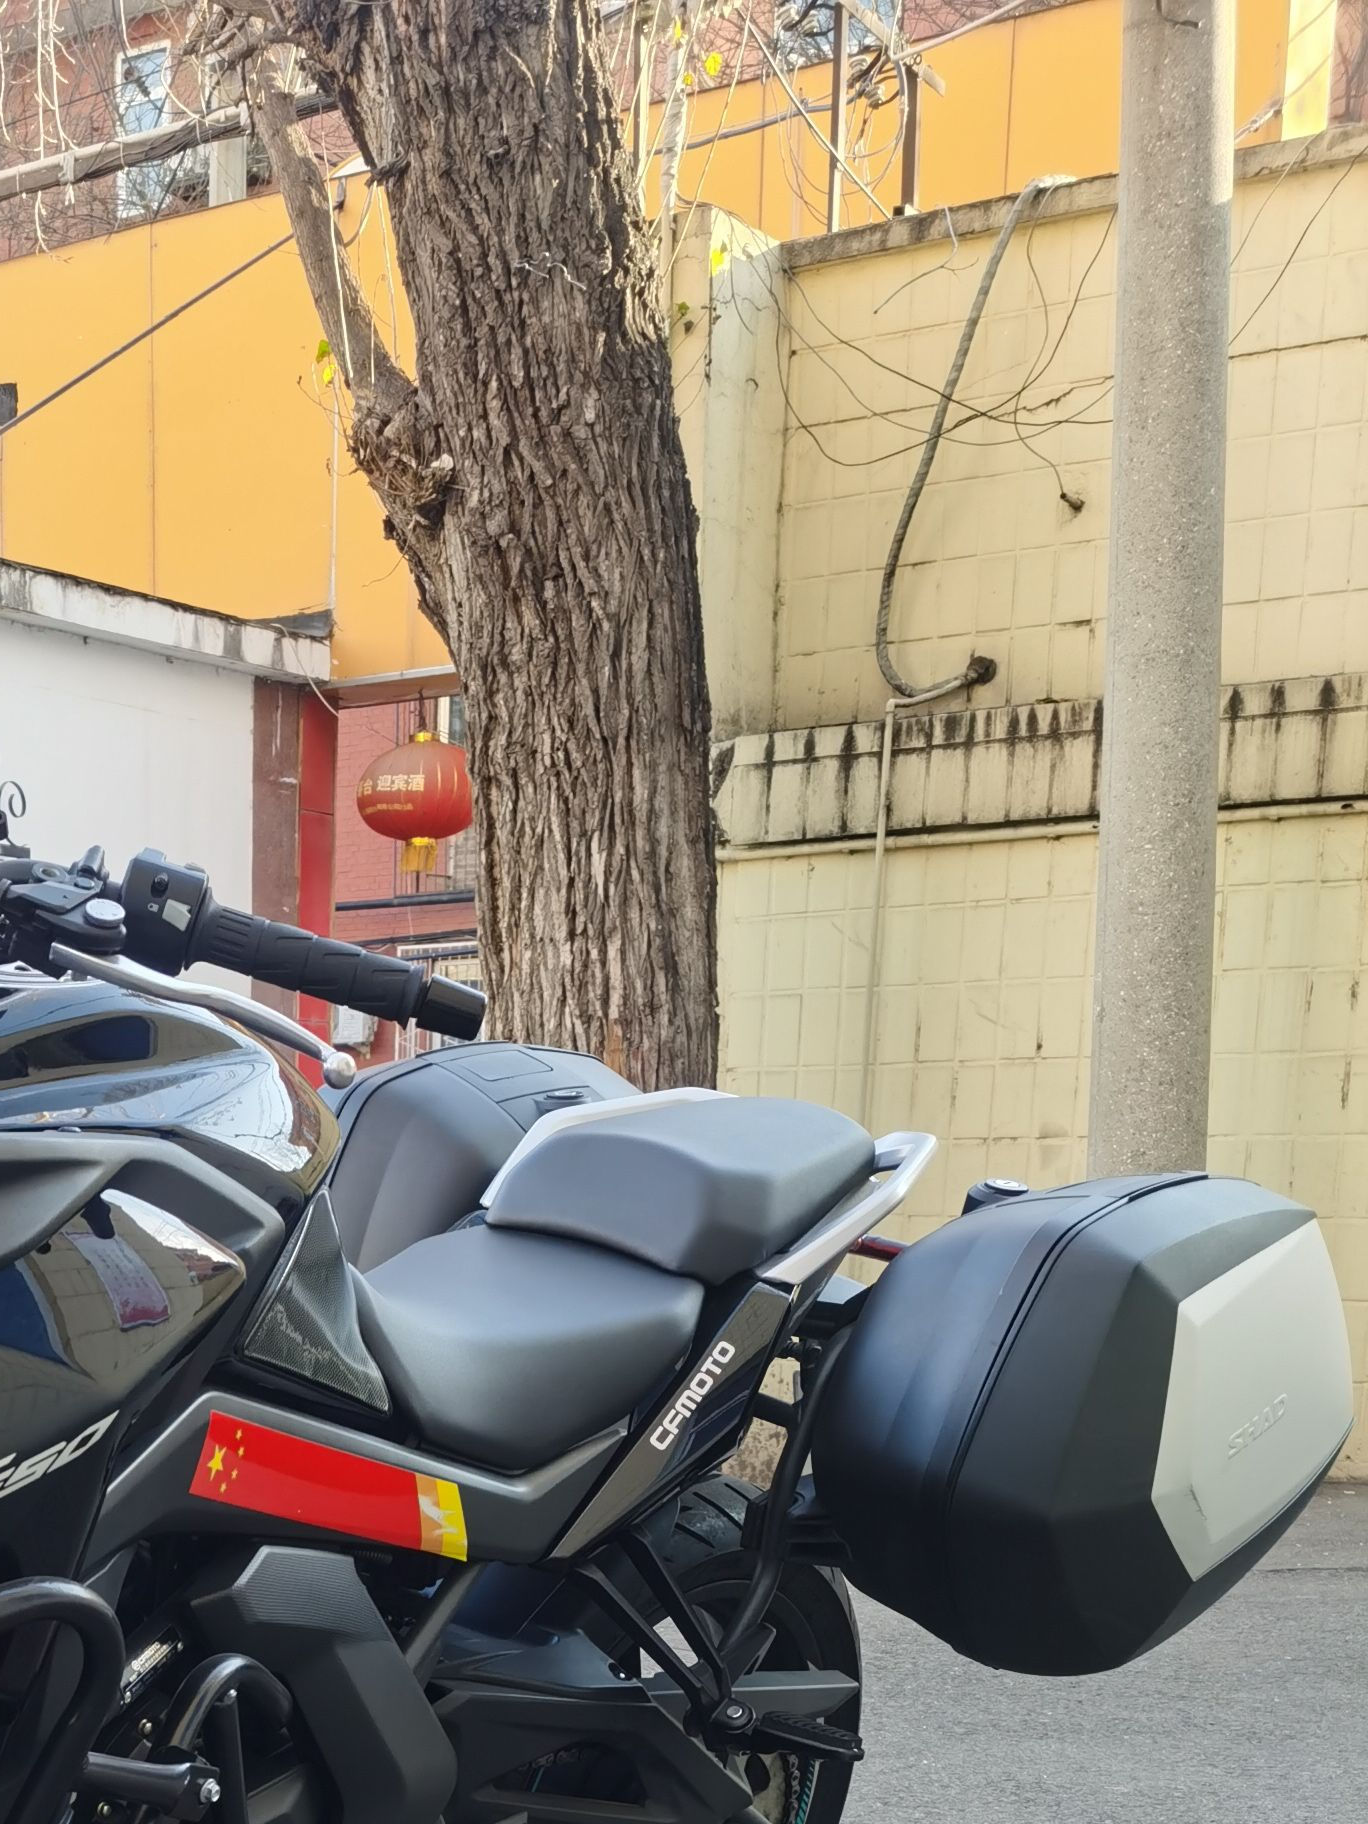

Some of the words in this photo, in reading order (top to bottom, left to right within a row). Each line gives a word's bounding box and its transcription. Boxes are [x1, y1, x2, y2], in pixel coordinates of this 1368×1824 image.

[376, 774, 425, 792] 迎宾酒
[650, 1341, 735, 1450] CFMOTO
